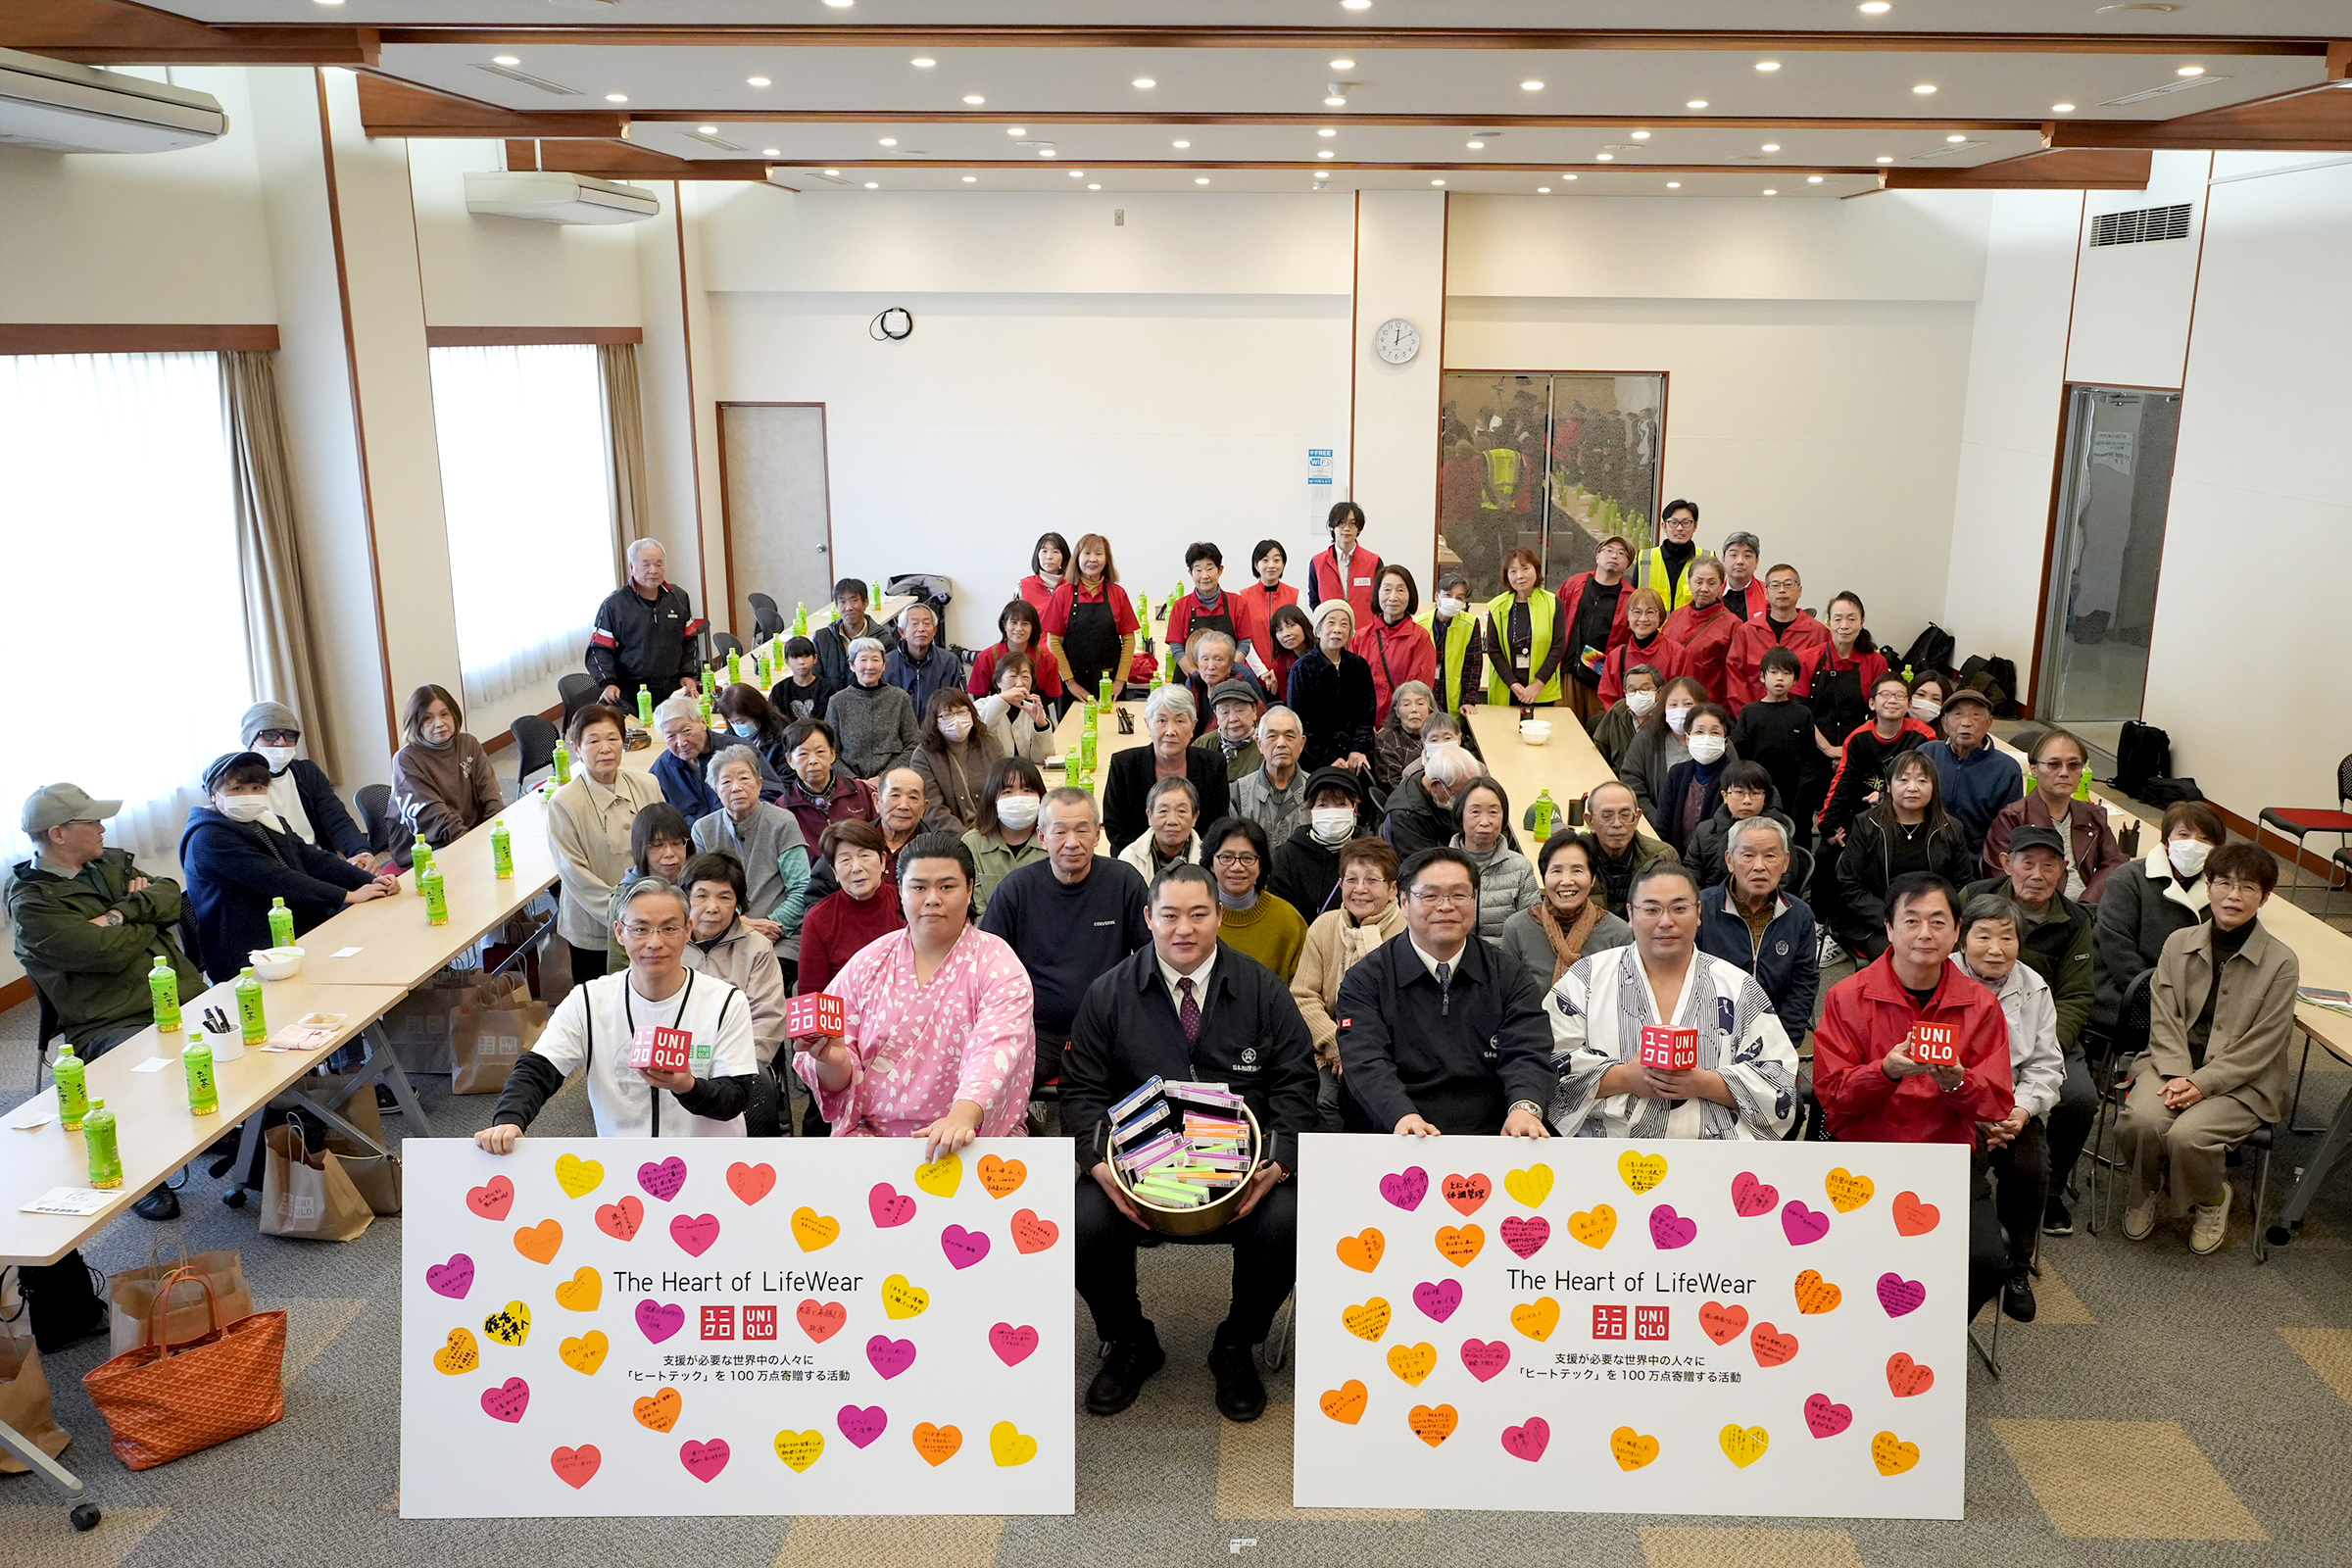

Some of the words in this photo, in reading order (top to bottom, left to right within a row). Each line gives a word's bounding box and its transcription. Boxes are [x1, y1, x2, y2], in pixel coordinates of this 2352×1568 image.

[819, 998, 840, 1013] UNI
[819, 1013, 842, 1031] QLO
[658, 1032, 685, 1050] UNI
[1676, 1035, 1693, 1050] UNI
[1921, 1027, 1951, 1044] UNI
[655, 1050, 685, 1067] QLO
[1674, 1051, 1694, 1067] QLO
[1919, 1044, 1953, 1060] QLO
[1449, 1180, 1478, 1189] とにかく
[1446, 1189, 1486, 1200] 体調管理
[613, 1271, 654, 1293] The
[663, 1271, 722, 1293] Heart
[732, 1271, 752, 1293] of
[764, 1271, 863, 1293] LifeWear
[1507, 1269, 1546, 1290] The
[1556, 1270, 1615, 1292] Heart
[1625, 1271, 1645, 1292] of
[1657, 1272, 1757, 1295] LifeWear
[747, 1309, 771, 1322] UNI
[1639, 1309, 1663, 1323] UNI
[746, 1324, 774, 1338] QLO
[1639, 1324, 1666, 1338] QLO
[663, 1353, 814, 1367] 支援が必要な世界中の人々に
[1392, 1350, 1426, 1363] どんなことを
[1554, 1352, 1706, 1367] 支援が必要な世界中の人々に
[1401, 1370, 1425, 1379] 楽しみ!
